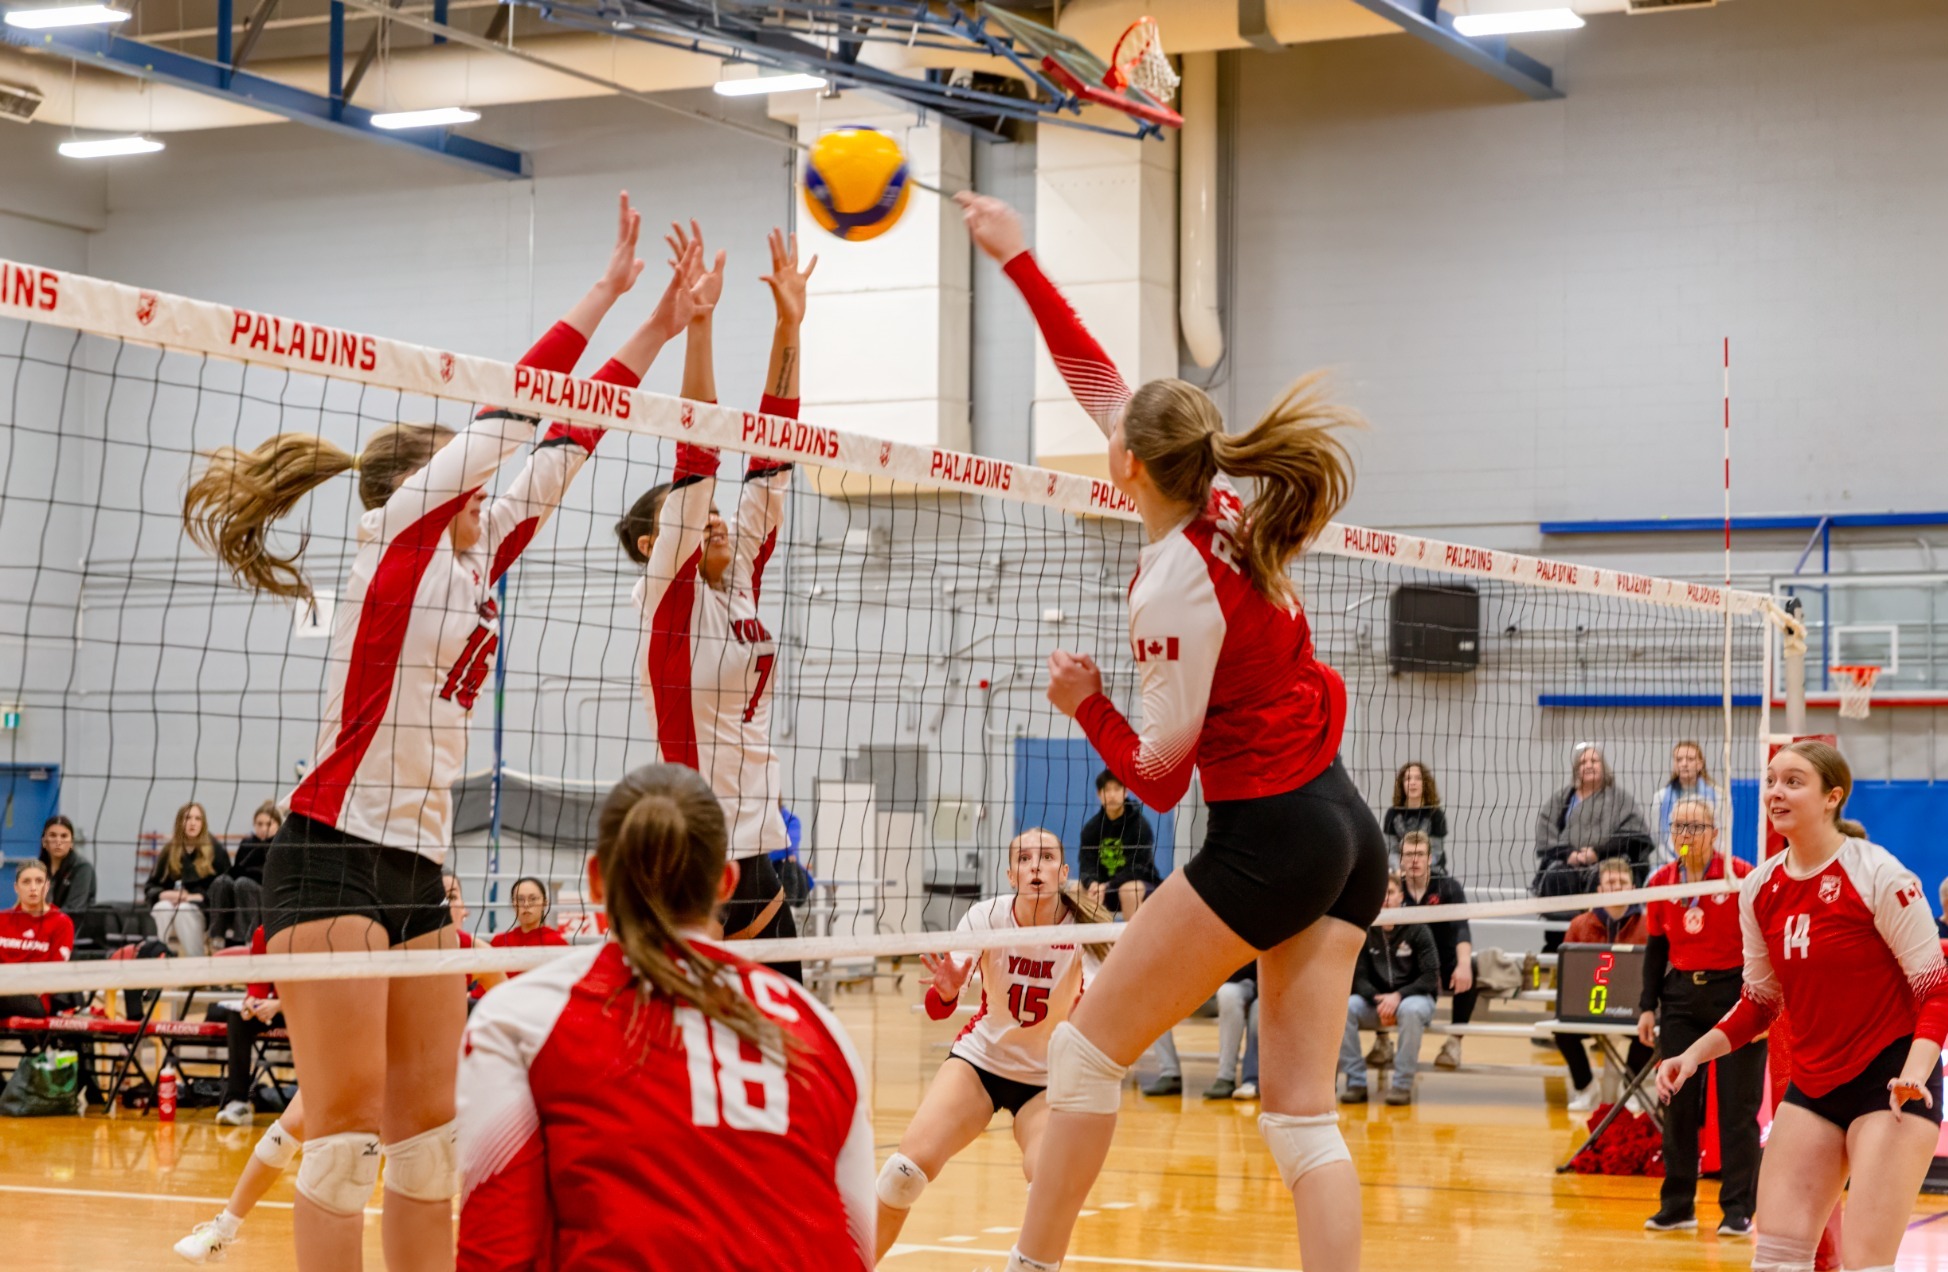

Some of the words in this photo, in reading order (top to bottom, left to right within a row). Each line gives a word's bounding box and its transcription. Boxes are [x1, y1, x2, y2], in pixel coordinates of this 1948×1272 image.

[230, 309, 376, 372] PALADINS
[514, 367, 632, 420] PALADINS
[742, 412, 839, 459] PALADINS
[930, 450, 1013, 491] PALADINS
[1090, 480, 1140, 513] PALAD
[1344, 527, 1397, 557] PALADINS
[1445, 545, 1493, 572] PALADINS
[439, 624, 499, 711] 16
[741, 653, 775, 723] 7
[1784, 913, 1811, 960] 14
[1008, 955, 1056, 979] YORK
[1593, 951, 1615, 986] 2
[1007, 983, 1051, 1029] 15
[1588, 985, 1608, 1015] 0
[673, 1005, 790, 1136] 18
